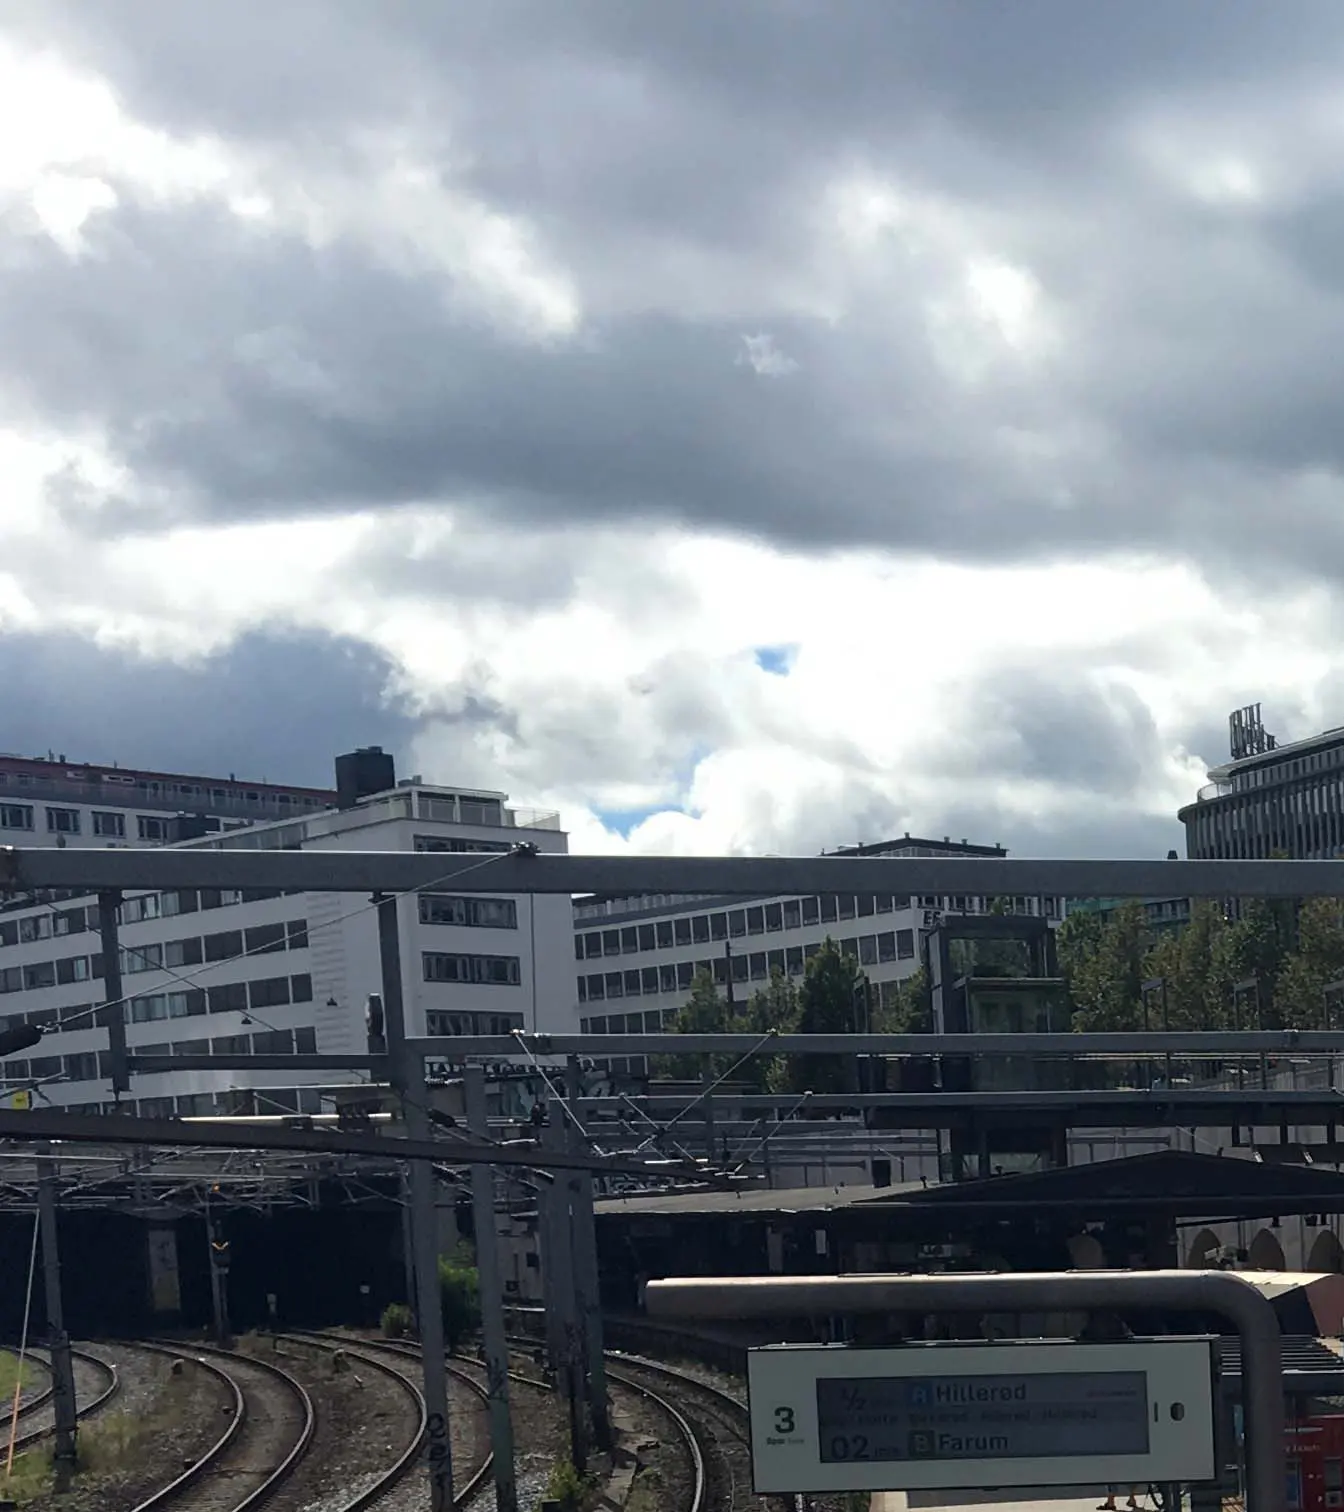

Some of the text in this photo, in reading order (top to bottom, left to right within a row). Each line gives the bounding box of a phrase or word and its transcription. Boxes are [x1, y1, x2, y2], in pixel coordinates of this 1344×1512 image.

[936, 1384, 1027, 1403] Hillerød
[775, 1407, 795, 1434] 3
[831, 1435, 870, 1460] 02
[939, 1434, 1008, 1454] Farum
